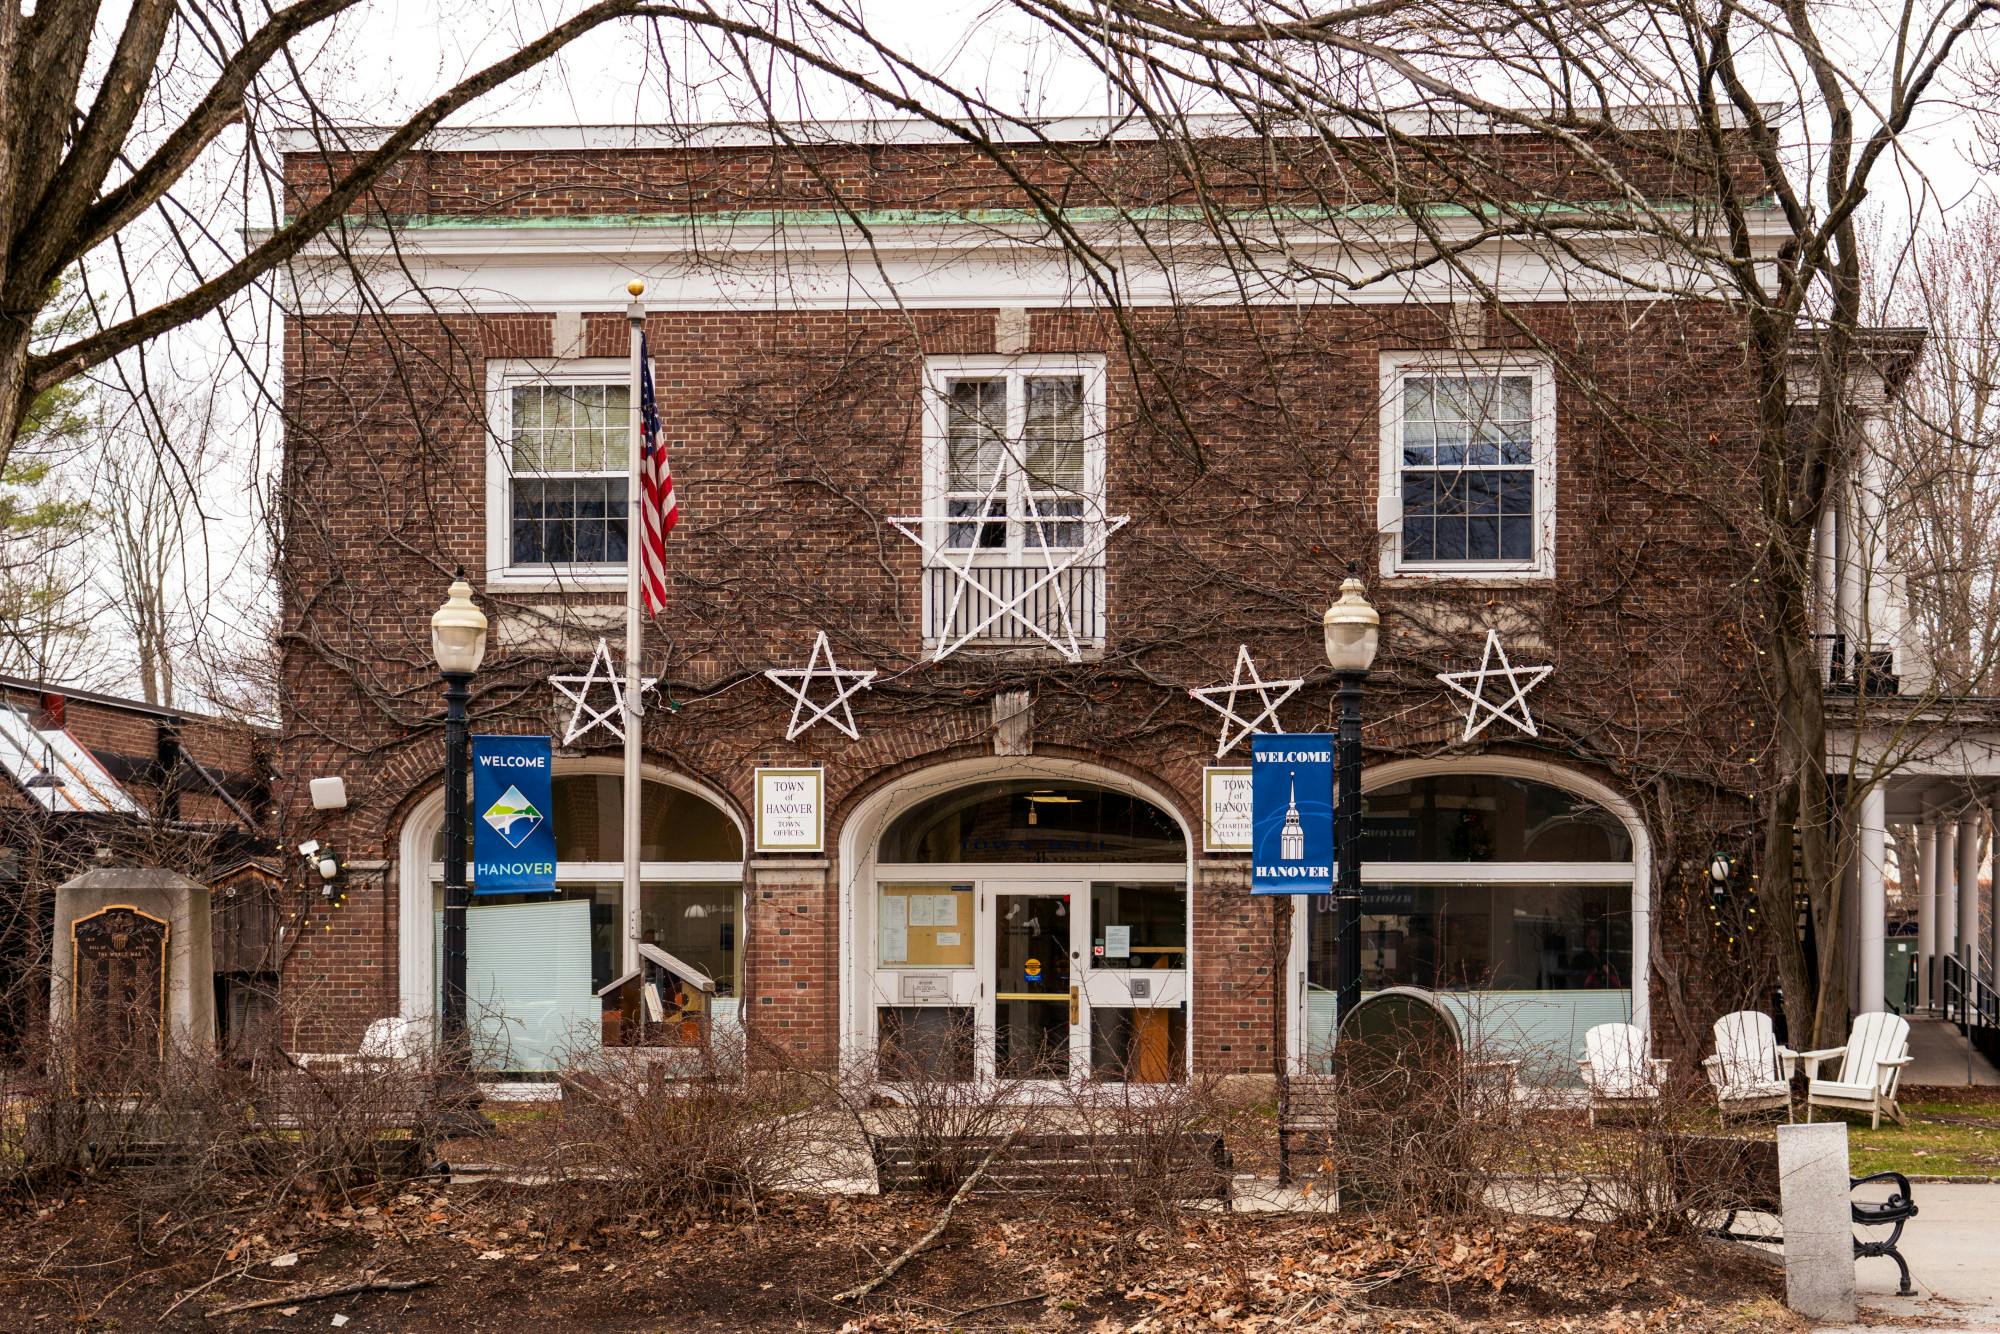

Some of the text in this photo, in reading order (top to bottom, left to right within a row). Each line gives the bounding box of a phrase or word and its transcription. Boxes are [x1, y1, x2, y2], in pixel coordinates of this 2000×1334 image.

[479, 755, 545, 768] WELCOME
[1255, 751, 1331, 763] WELCOME
[774, 782, 804, 792] TOWN
[1223, 780, 1254, 790] TOWN
[766, 803, 812, 814] HANOVER
[1215, 802, 1253, 813] HANOV
[477, 863, 553, 875] HANOVER
[1255, 866, 1330, 878] HANOVER
